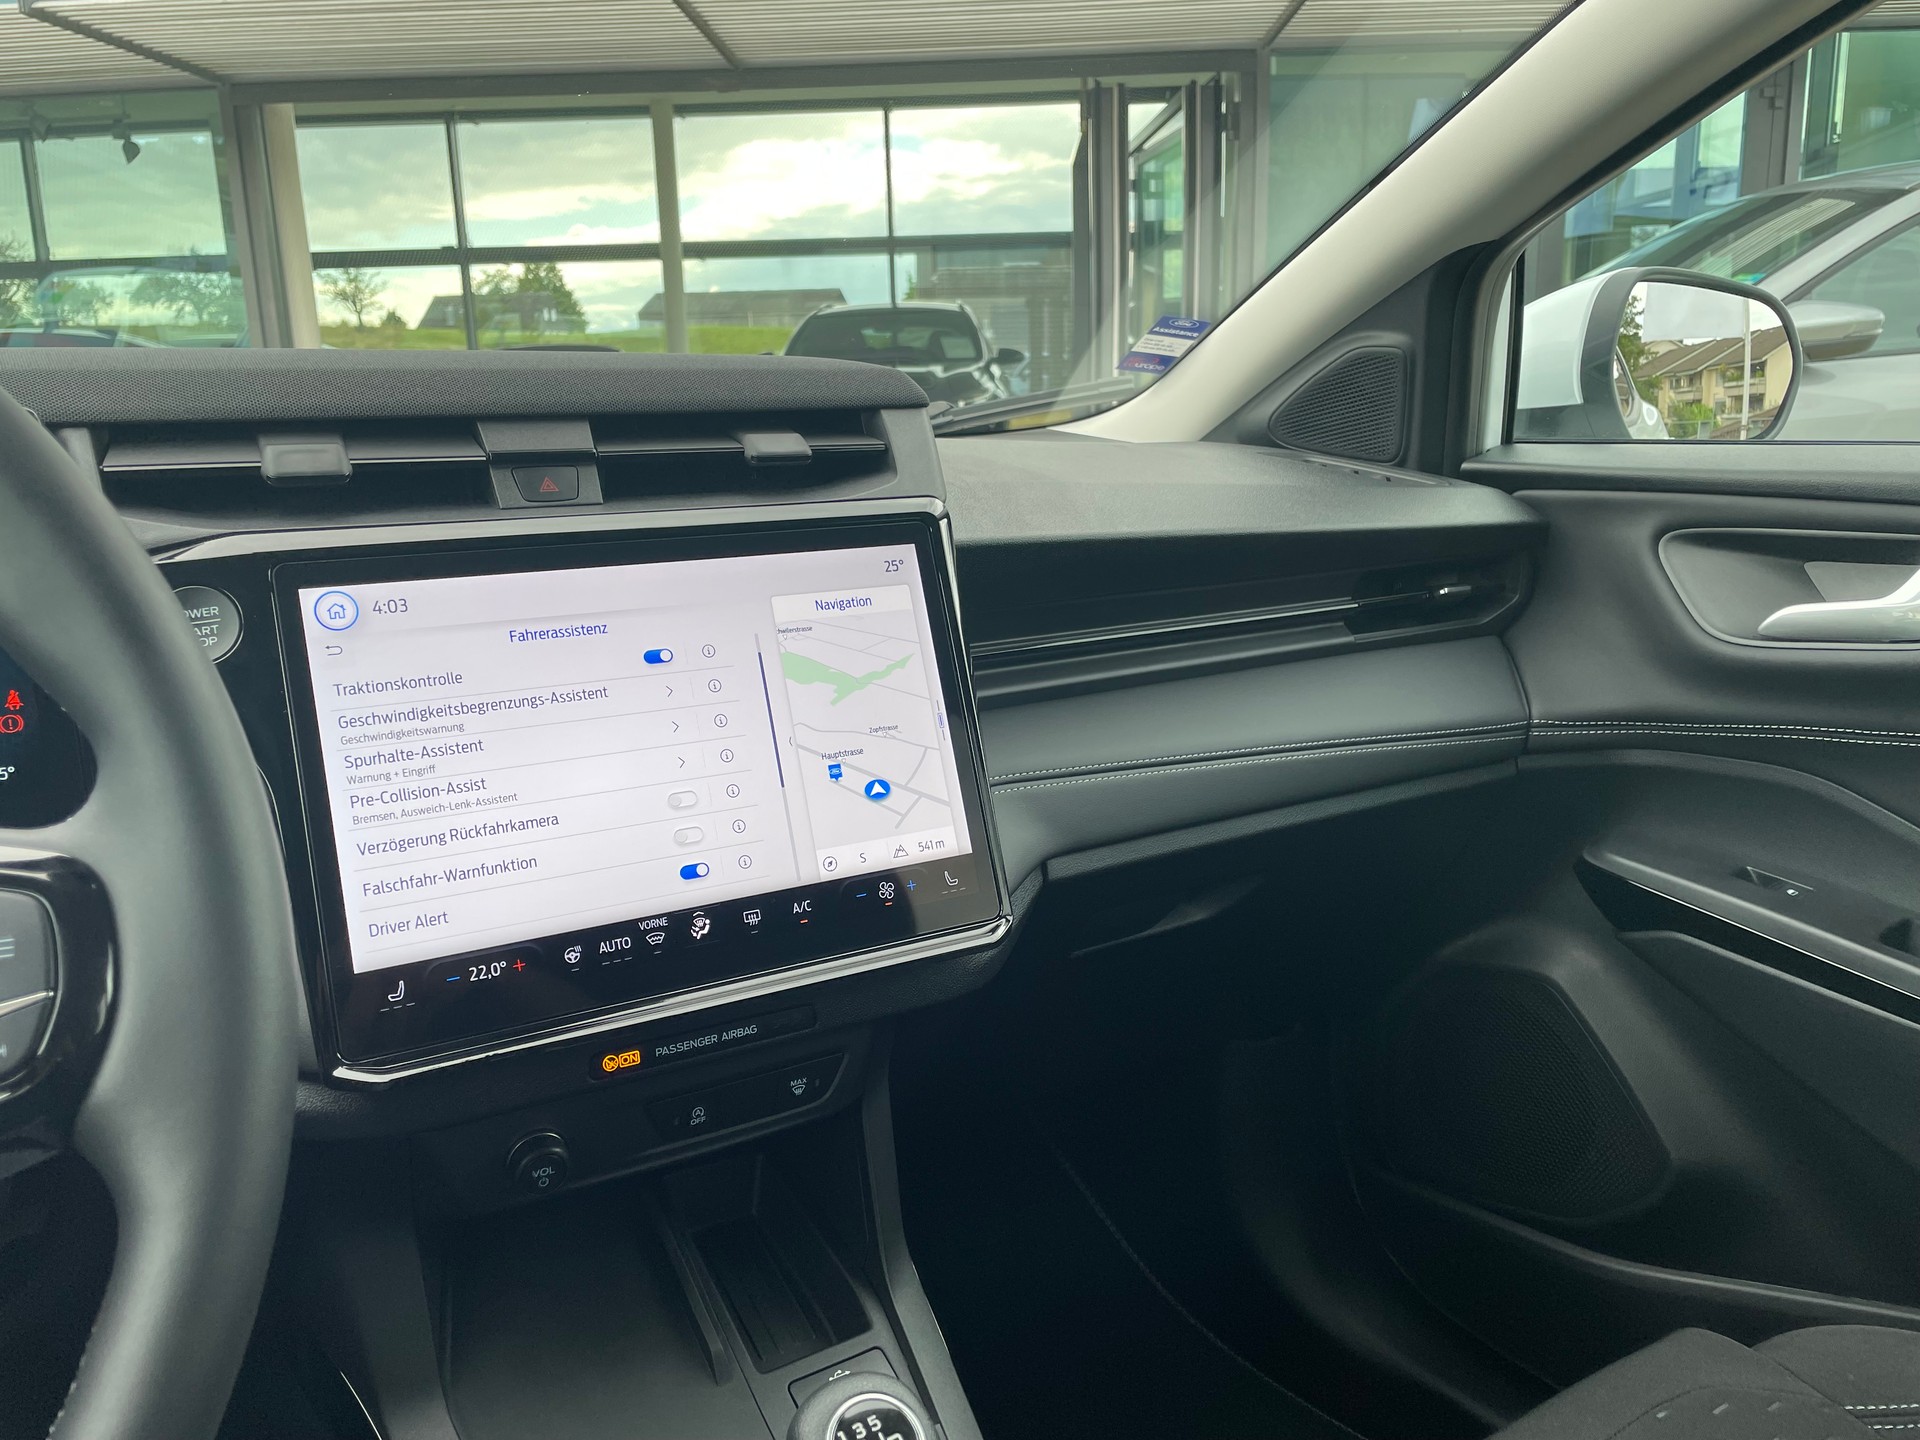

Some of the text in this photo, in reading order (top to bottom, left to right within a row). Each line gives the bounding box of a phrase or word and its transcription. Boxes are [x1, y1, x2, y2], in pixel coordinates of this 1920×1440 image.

[1152, 326, 1199, 338] Assistance
[884, 559, 904, 573] 25°
[372, 598, 409, 615] 4:03
[815, 595, 873, 612] Navigation
[509, 622, 608, 643] Fahrerassistenz
[333, 671, 463, 697] Traktionskontrolle
[338, 685, 609, 729] Geschwindigkeitsbegrenzungs-Assistent
[340, 721, 465, 746] Geschwindigkeitswarnung
[869, 724, 899, 734] Zopfstrasse
[343, 739, 485, 771] Spurhalte-Assistent
[821, 747, 864, 760] Hauptstrasse
[346, 770, 391, 786] Warnung
[402, 764, 436, 780] Eingriff
[350, 777, 488, 809] Pre-Collision-Assist
[352, 792, 518, 826] Bremsen, Ausweich-Lenk-Assistent
[356, 813, 560, 857] Verzögerung Rückfahrkamera
[859, 840, 945, 865] S 541 m
[362, 855, 538, 897] Falschfahr-Warnfunktion
[793, 900, 812, 914] A/C
[368, 911, 449, 938] Driver Alert
[638, 916, 668, 931] VORNE
[599, 936, 632, 954] AUTO
[469, 961, 507, 982] 22,0°
[621, 1024, 758, 1065] ON PASSENGER AIRBAG
[790, 1077, 807, 1087] MAX
[690, 1115, 706, 1126] OFF
[532, 1166, 555, 1178] VOL
[852, 1422, 867, 1439] 3
[866, 1414, 882, 1432] 5
